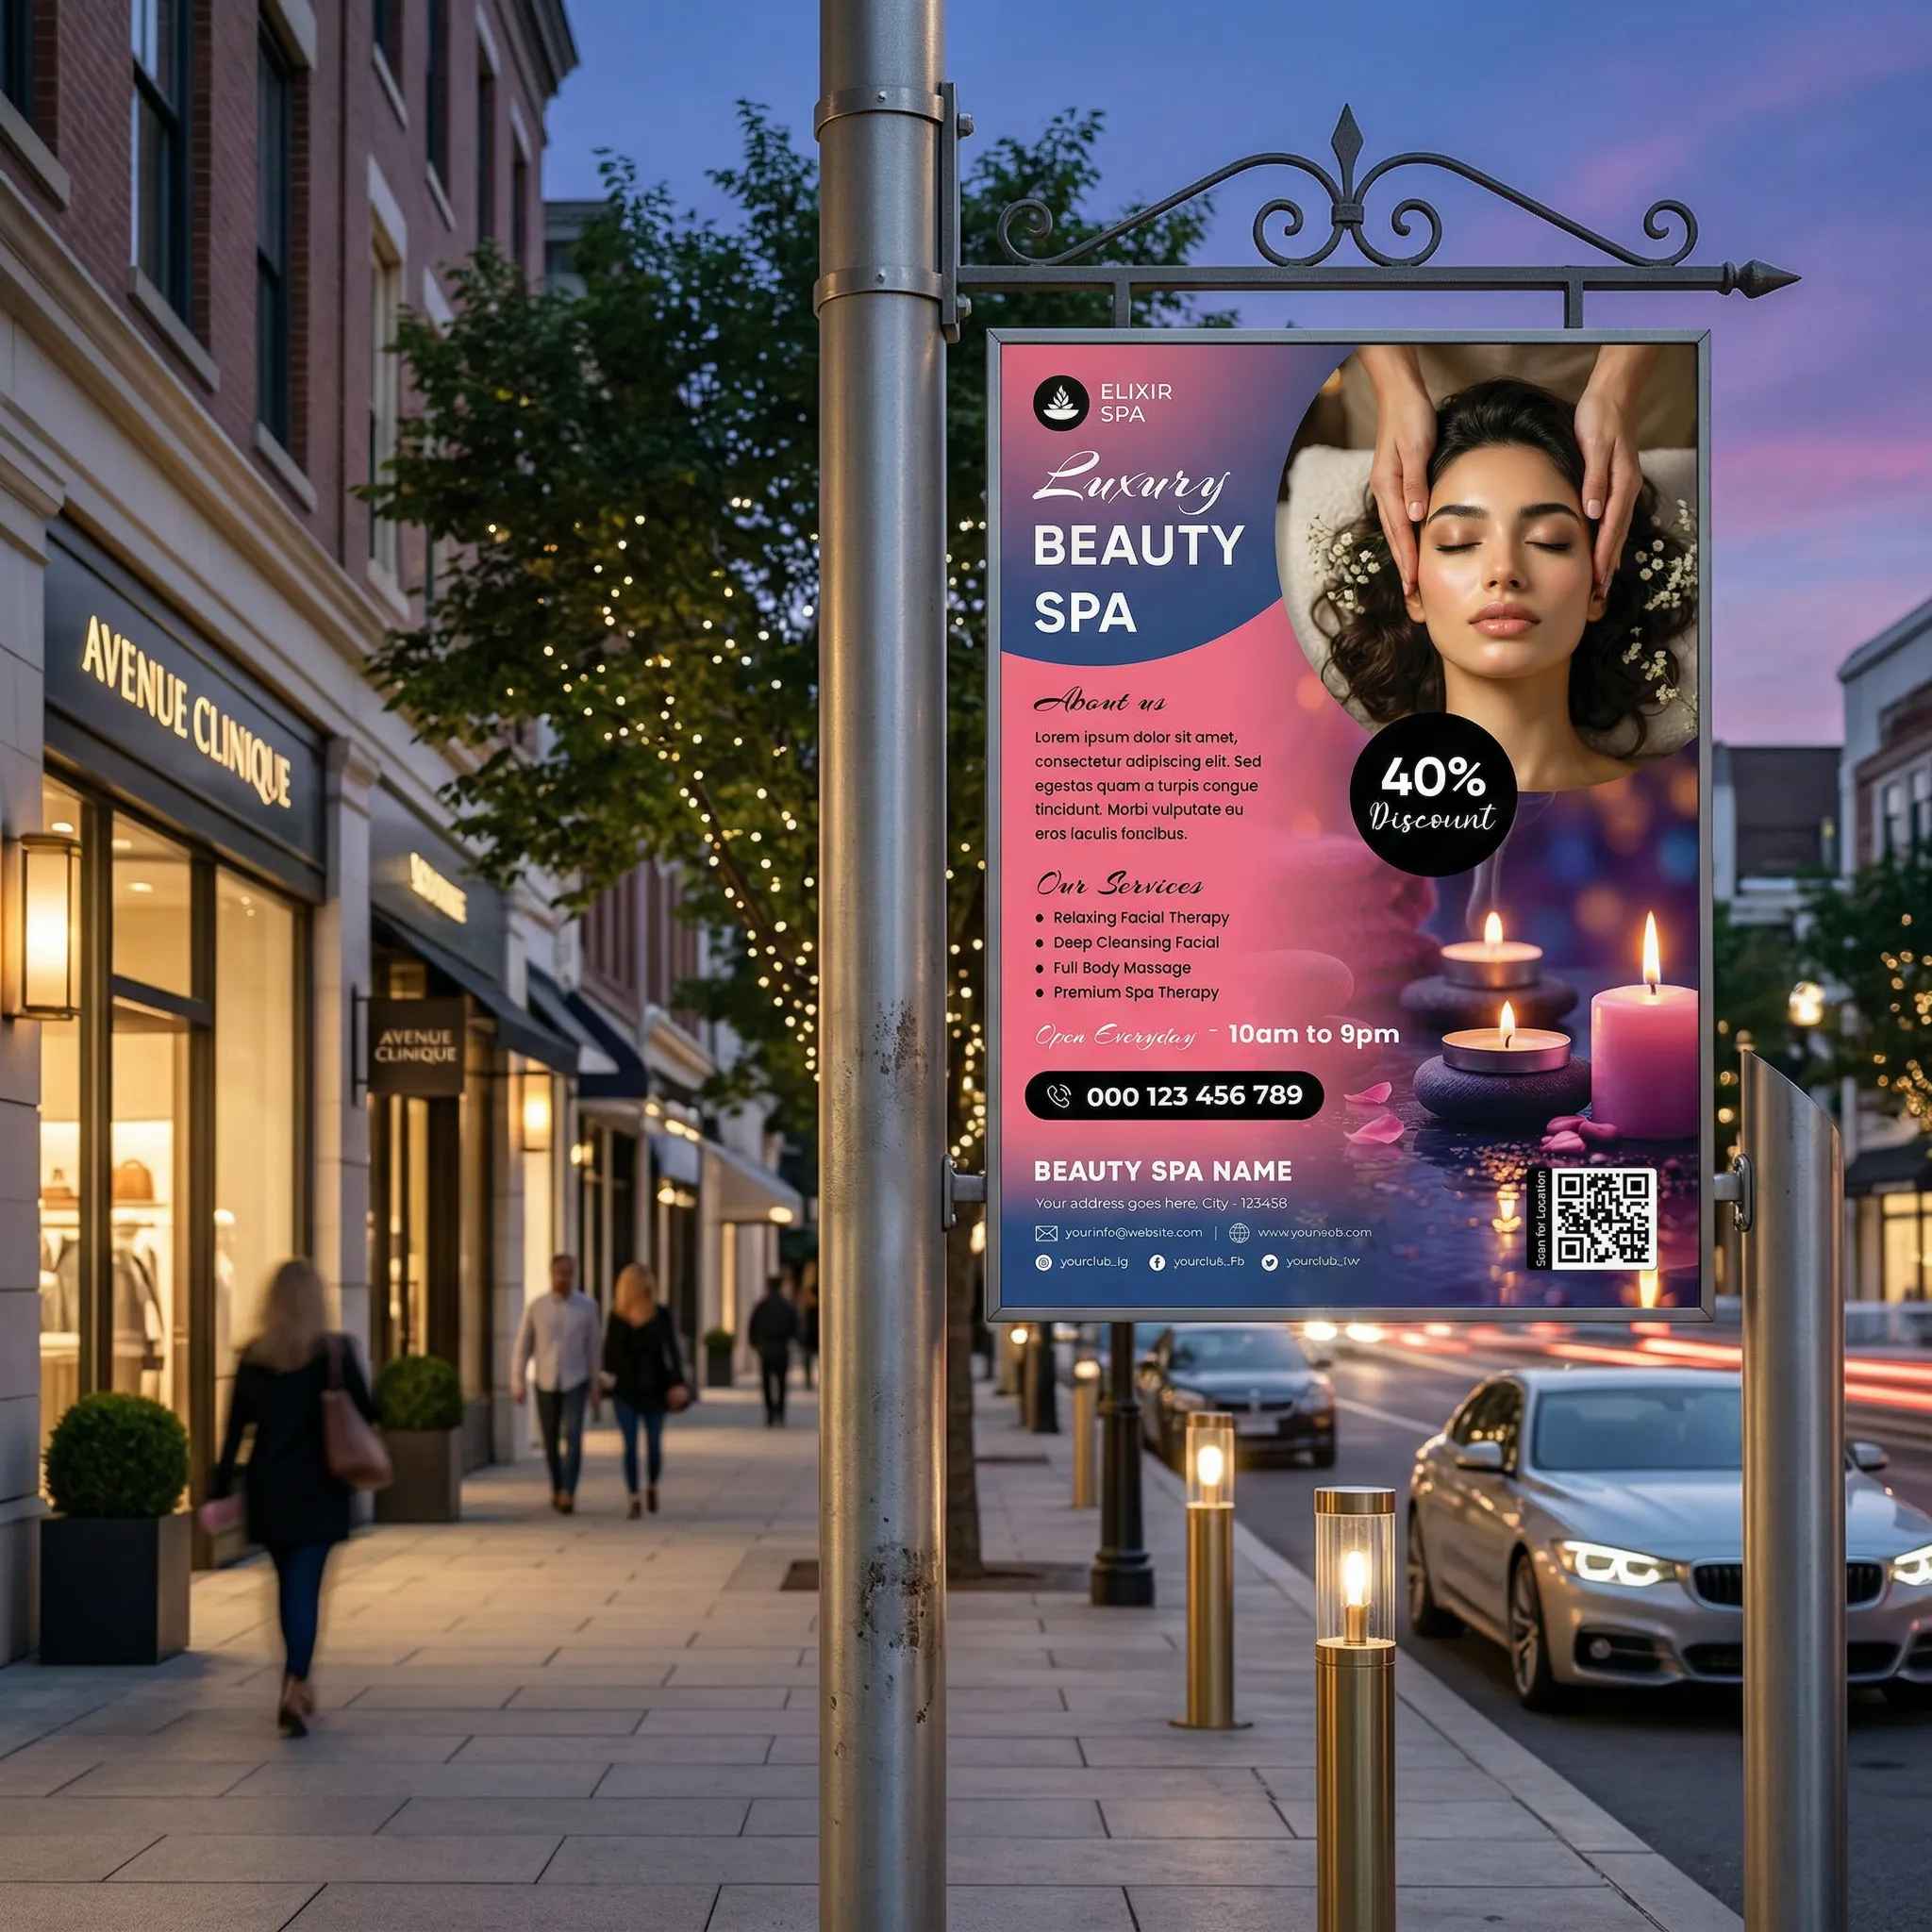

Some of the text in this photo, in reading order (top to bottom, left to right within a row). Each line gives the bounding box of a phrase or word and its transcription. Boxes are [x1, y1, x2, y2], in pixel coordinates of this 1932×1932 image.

[1100, 383, 1173, 400] ELIXIR
[1100, 406, 1146, 423] SPA
[1032, 450, 1232, 516] Luxury
[1034, 525, 1245, 566] BEAUTY
[1034, 591, 1137, 633] SPA
[1033, 685, 1168, 712] About us
[81, 615, 291, 808] AVENUE CLINIQUE
[1035, 730, 1239, 747] Lorem ipsum dolor sit amet,
[1035, 754, 1262, 772] consectetur adipiscing elit. Sed
[1381, 756, 1486, 797] 40%
[1035, 778, 1258, 796] egestas quam a turpis congue
[1035, 802, 1243, 820] tincidunt. Morbi vulputate eu
[1369, 801, 1497, 834] Discount
[1035, 828, 1067, 841] eros
[1037, 870, 1205, 895] Our Services
[1054, 910, 1230, 927] Relaxing Facial Therapy
[1054, 935, 1220, 953] Deep Cleansing Facial
[1054, 960, 1191, 978] Full Body Massage
[1054, 985, 1220, 1003] Premium Spa Therapy
[379, 1029, 453, 1046] AVENUE
[1035, 1023, 1086, 1051] Open
[1093, 1023, 1197, 1051] Everyday
[1228, 1024, 1299, 1044] 10am
[1306, 1024, 1333, 1044] to
[1340, 1024, 1400, 1050] 9pm
[374, 1046, 457, 1064] CLINIQUE
[1087, 1084, 1304, 1108] 000 123 456 789
[1034, 1160, 1292, 1182] BEAUTY SPA NAME
[1035, 1197, 1067, 1209] Your
[1070, 1197, 1124, 1209] address
[1127, 1200, 1161, 1211] goes
[1165, 1197, 1198, 1210] here,
[1202, 1197, 1229, 1211] City
[1065, 1226, 1203, 1241] yourinfo@website.com
[1536, 1222, 1546, 1238] for
[1536, 1240, 1546, 1267] Scan
